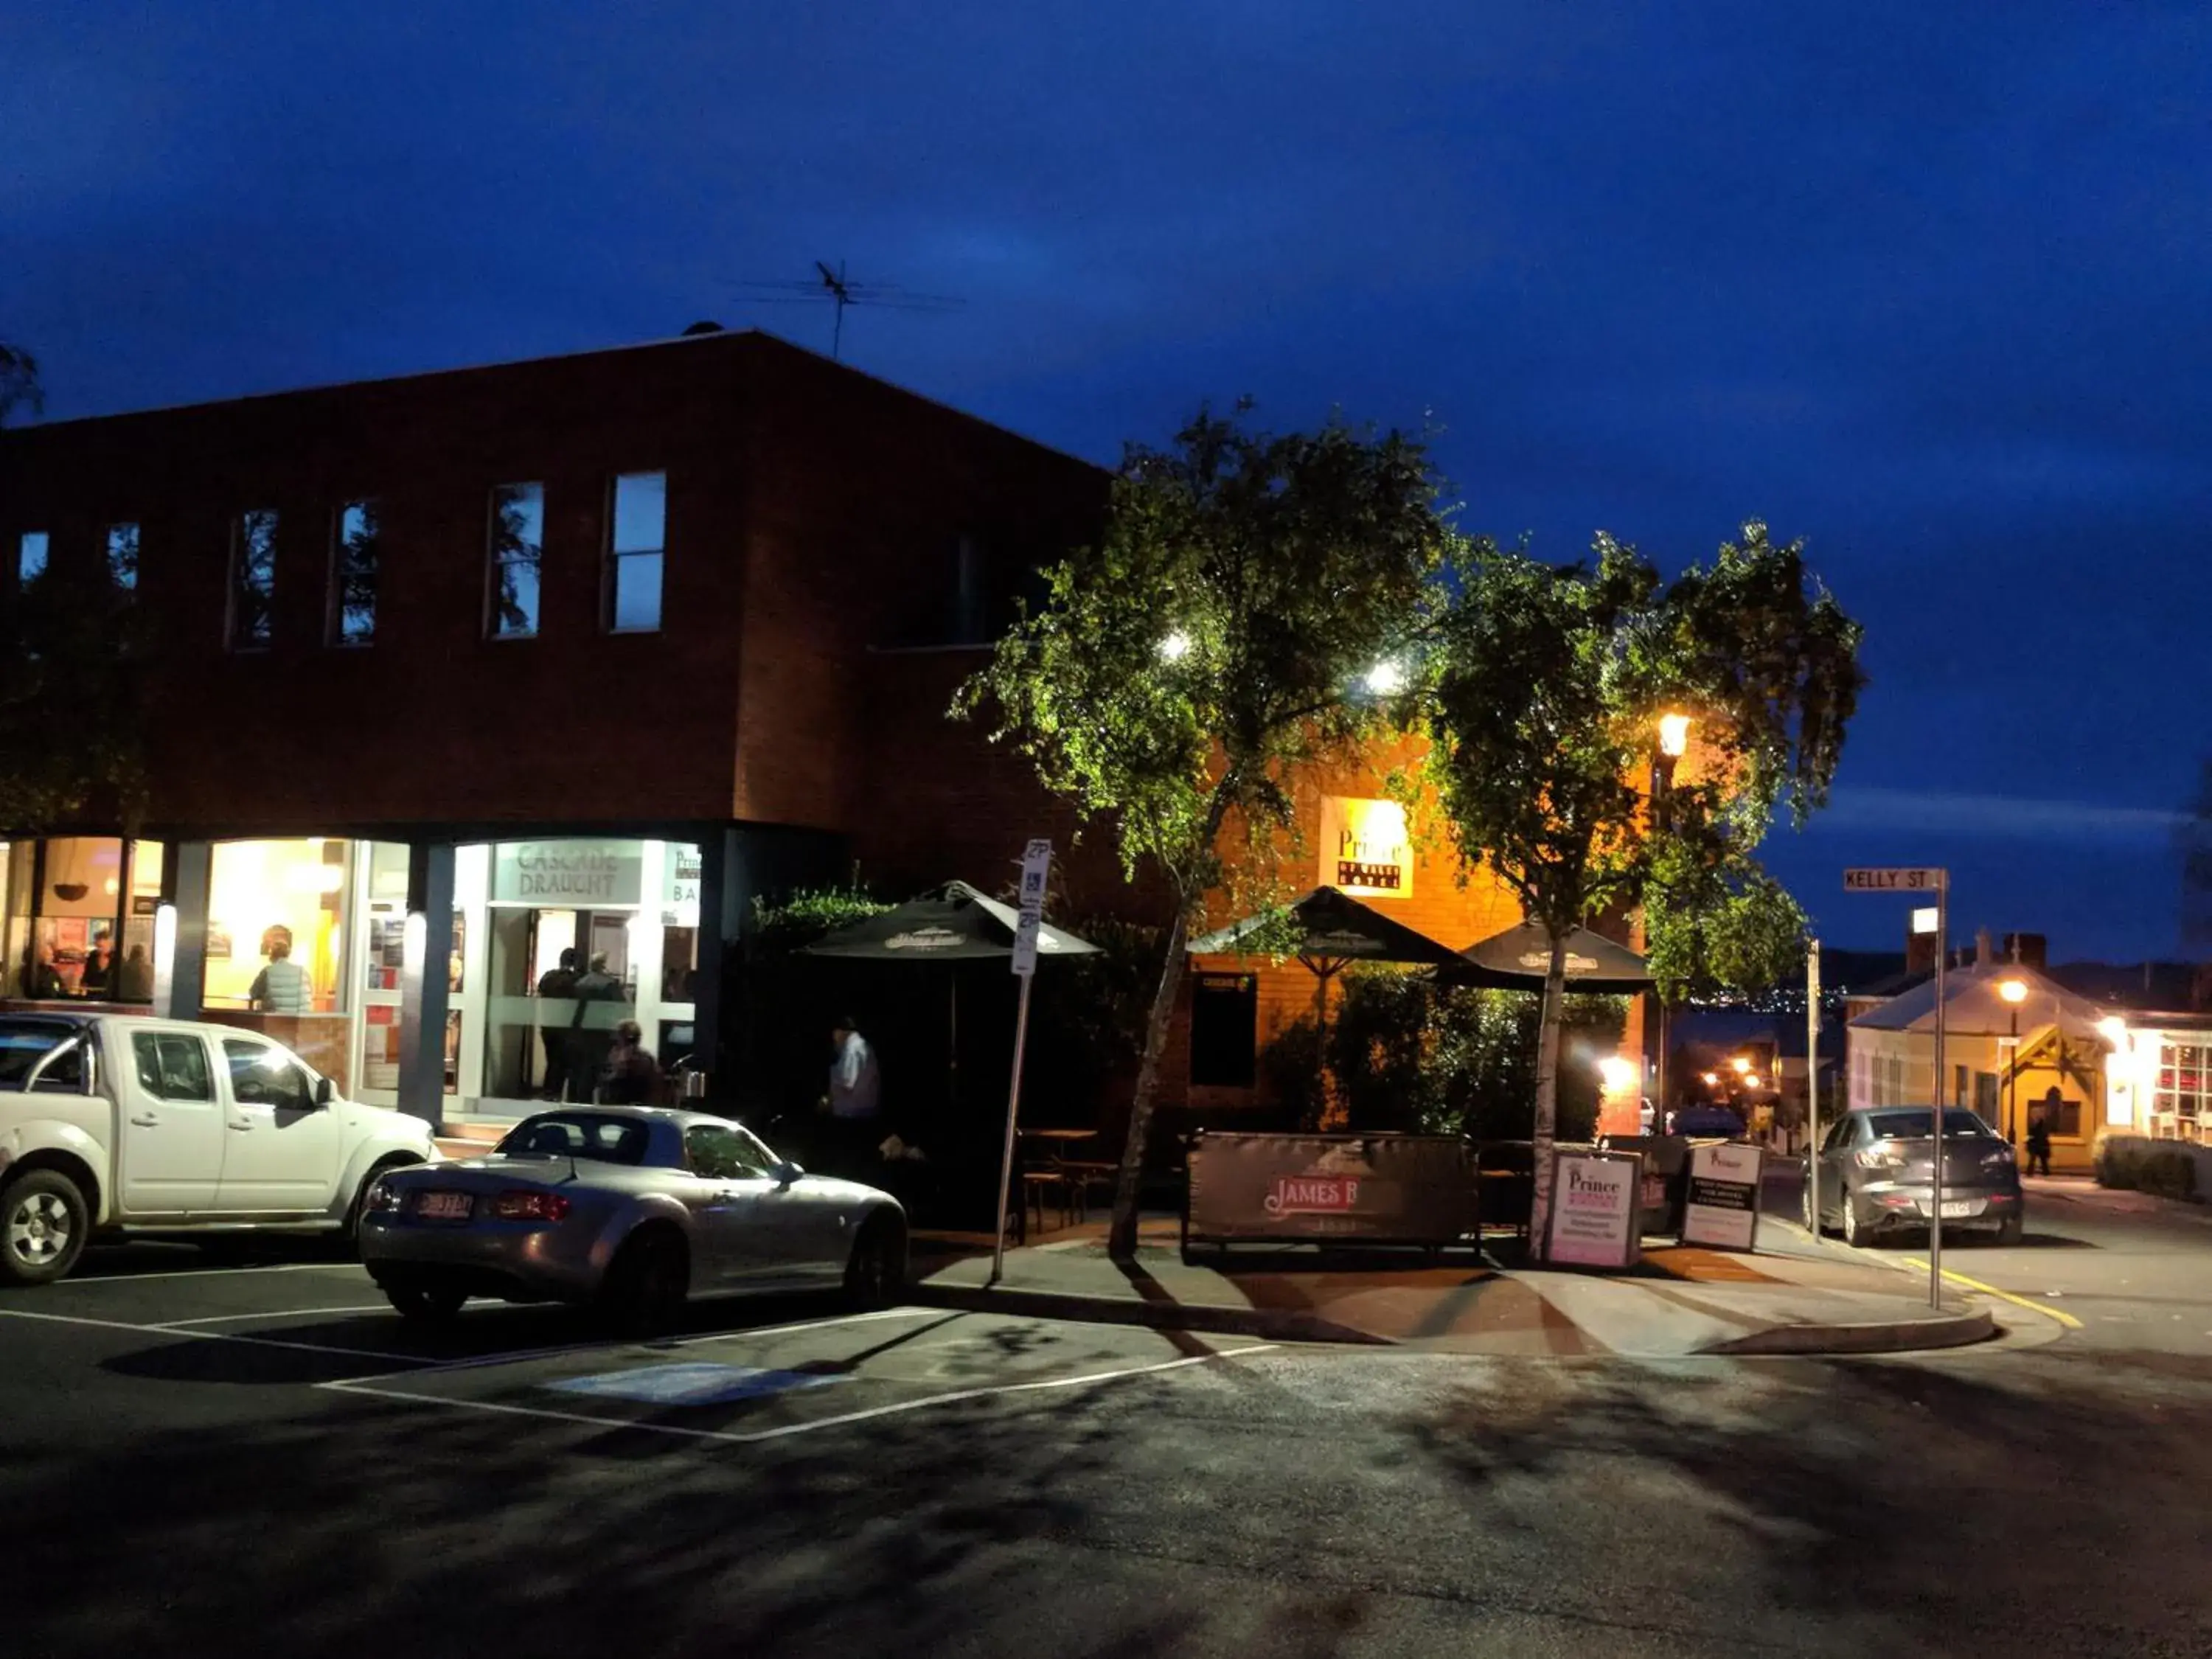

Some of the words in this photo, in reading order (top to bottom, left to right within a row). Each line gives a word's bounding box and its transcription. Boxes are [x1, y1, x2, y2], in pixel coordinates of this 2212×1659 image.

[1027, 841, 1048, 859] 2P
[1339, 828, 1402, 861] Price
[518, 846, 618, 872] CASCADE
[519, 873, 617, 898] DRAUGHT
[1846, 870, 1898, 888] KELLY
[1908, 870, 1926, 888] ST
[1569, 1171, 1621, 1192] Prince
[1264, 1179, 1340, 1214] JAMES
